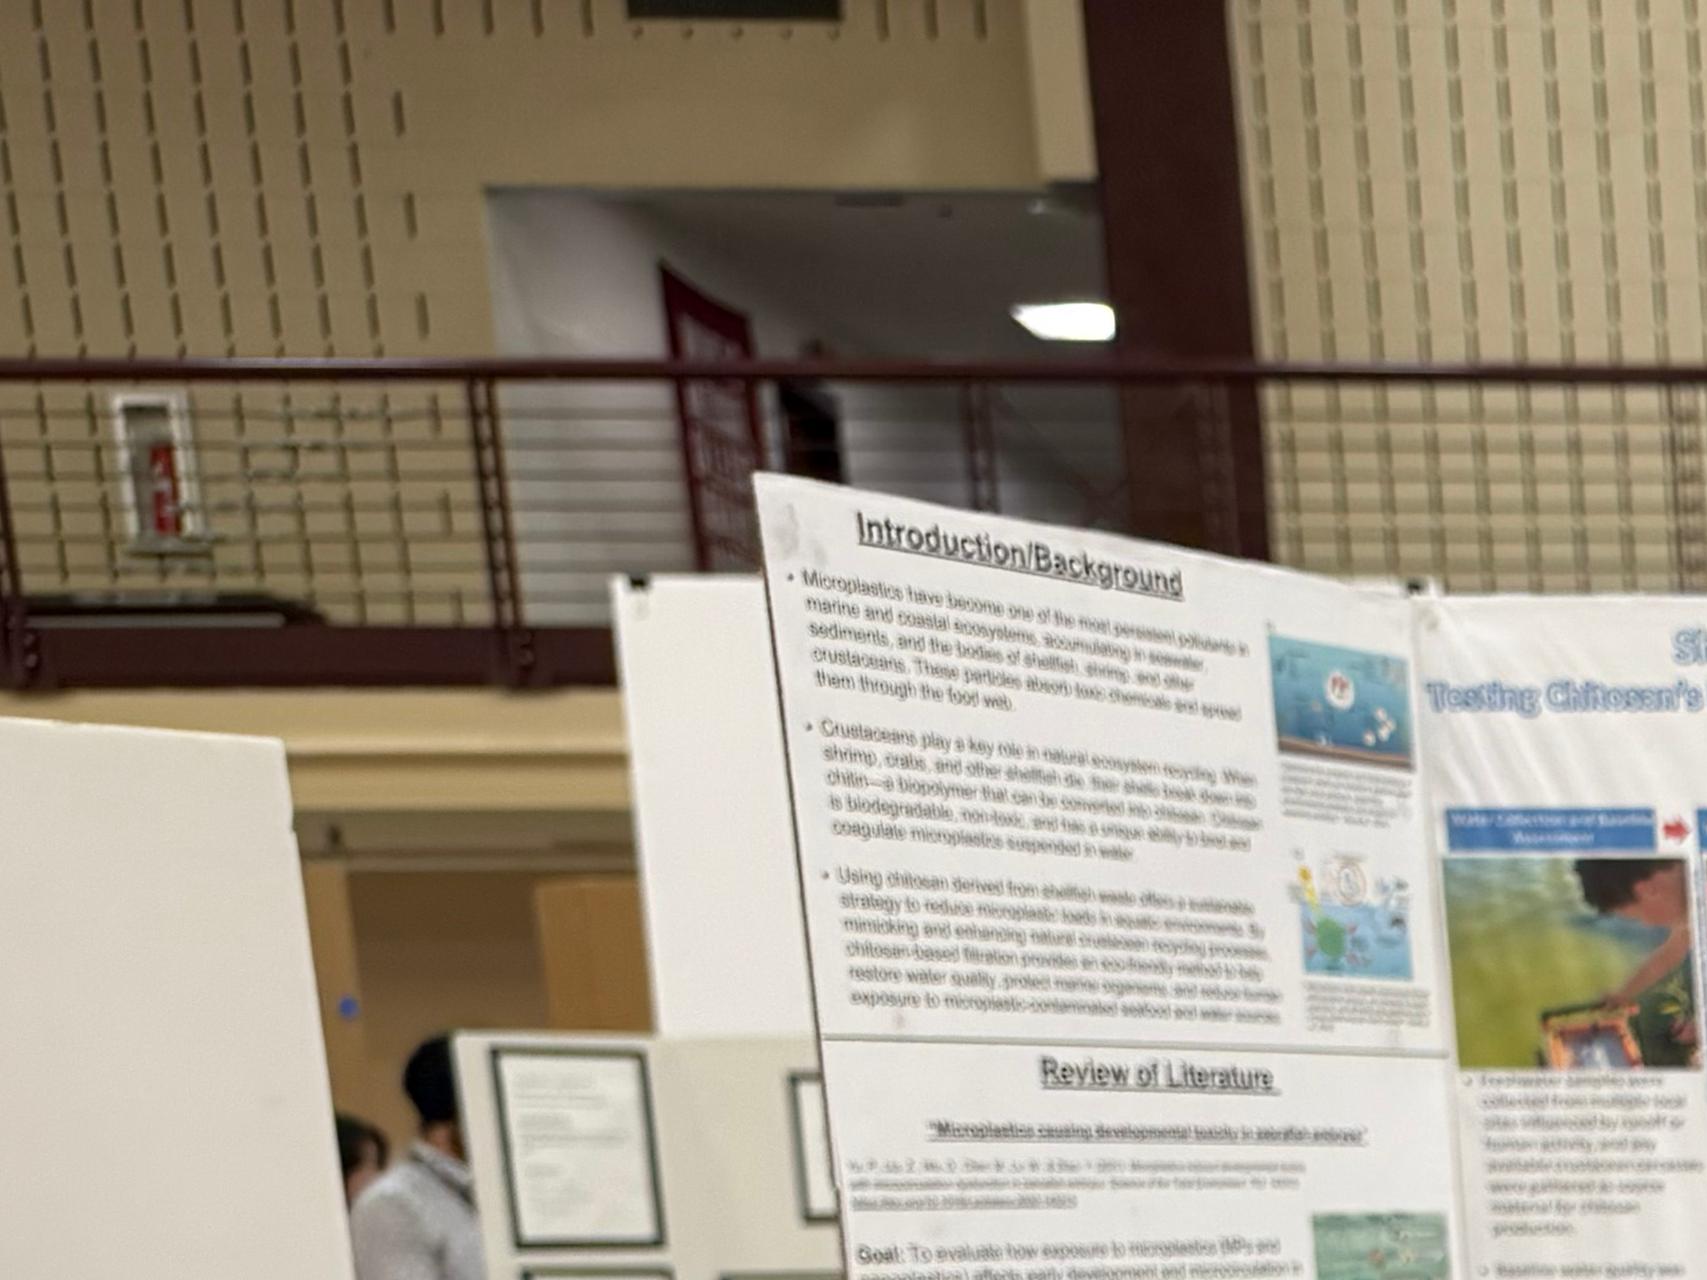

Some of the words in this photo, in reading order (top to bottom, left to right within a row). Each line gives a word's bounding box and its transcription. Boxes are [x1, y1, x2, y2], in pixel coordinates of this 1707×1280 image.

[857, 513, 1183, 597] Introduction/Background
[1428, 682, 1541, 718] Testing
[1040, 1057, 1130, 1088] Review
[1137, 1059, 1159, 1087] of
[1166, 1062, 1273, 1090] Literature
